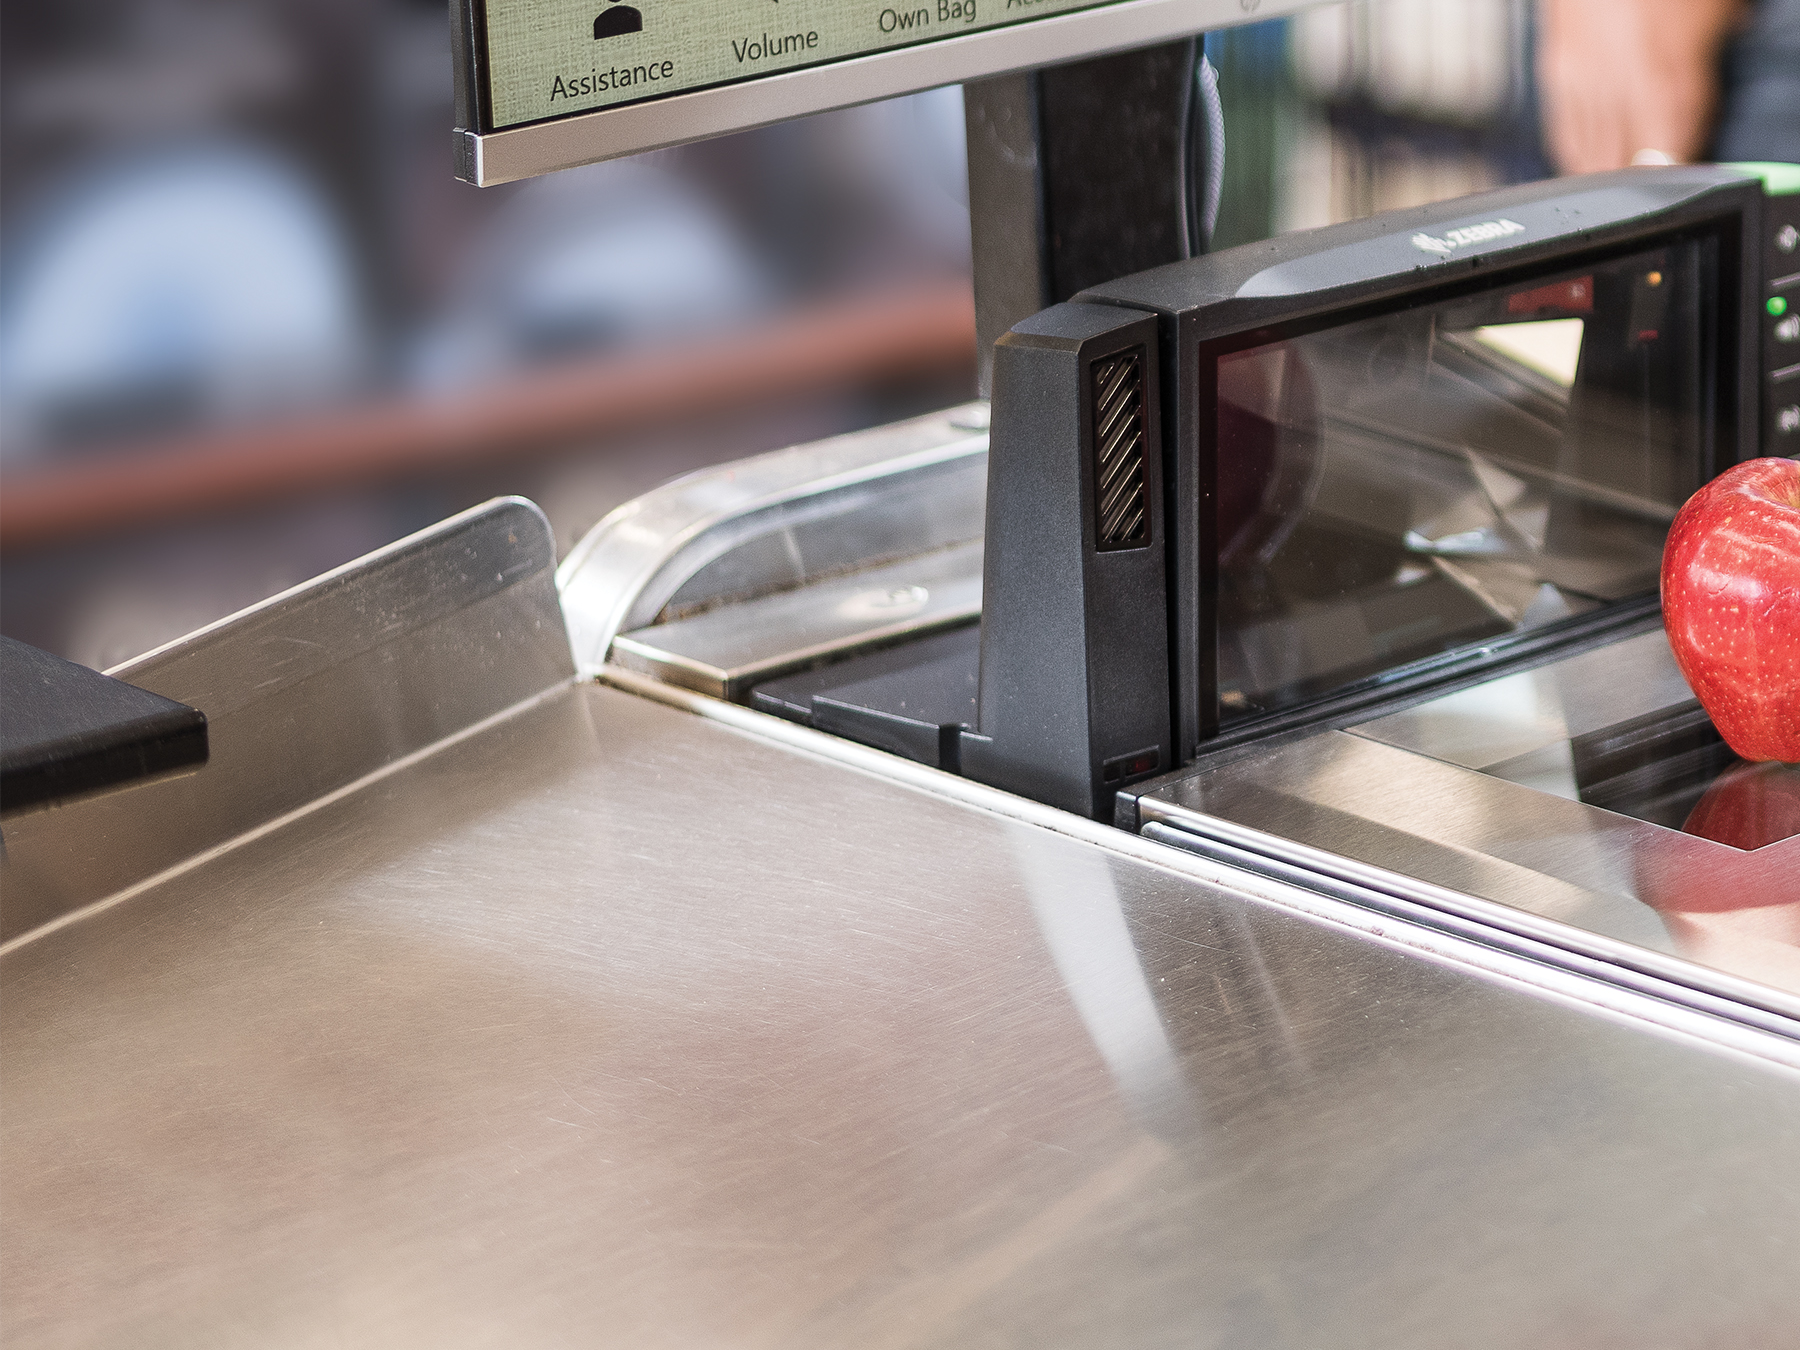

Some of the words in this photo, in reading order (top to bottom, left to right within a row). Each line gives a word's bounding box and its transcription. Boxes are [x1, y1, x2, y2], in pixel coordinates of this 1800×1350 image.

[879, 7, 930, 34] Own
[732, 27, 819, 64] Volume
[550, 56, 674, 102] Assistance
[1446, 218, 1526, 247] ZEBRA
